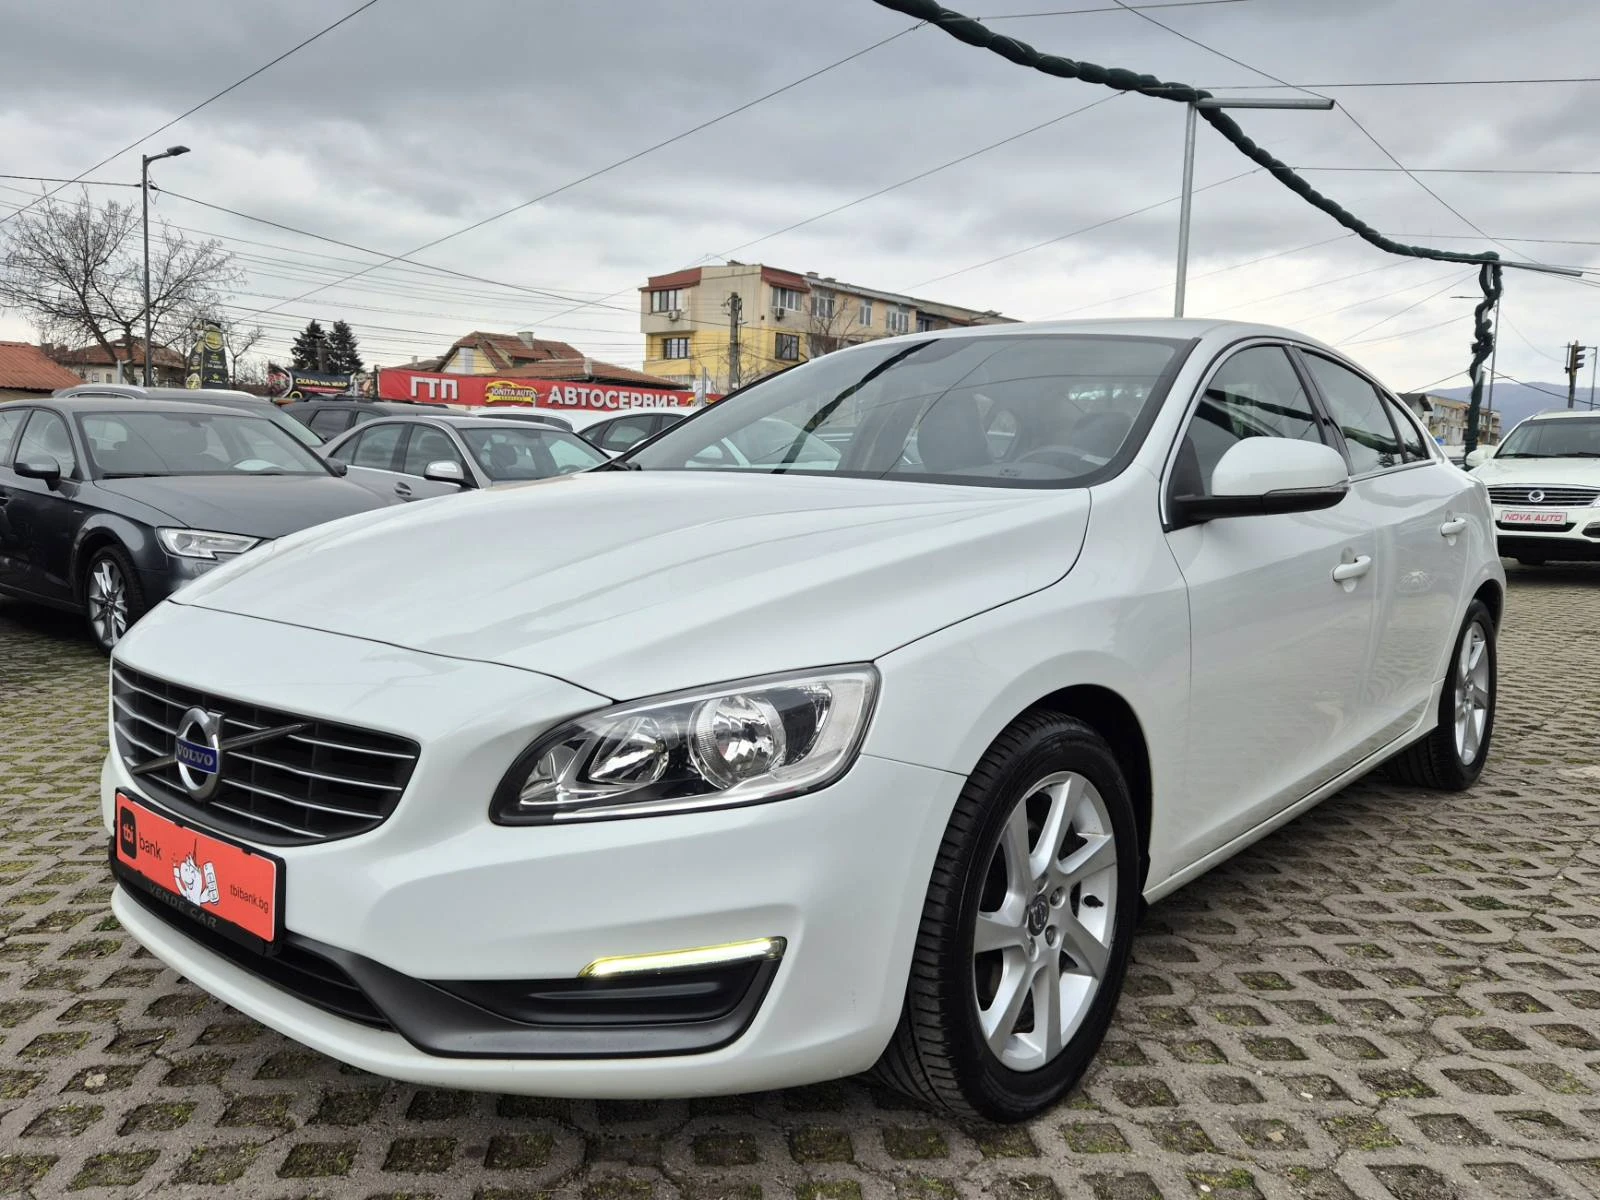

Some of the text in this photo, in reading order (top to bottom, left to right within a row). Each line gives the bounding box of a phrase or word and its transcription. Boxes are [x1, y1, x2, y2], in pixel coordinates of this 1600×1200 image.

[295, 377, 320, 386] СКАРА
[411, 376, 458, 400] ГТП
[516, 389, 535, 398] AUTO
[547, 385, 679, 409] АВТОСЕРВИЗ
[1504, 512, 1563, 522] NOVA AUTO
[177, 743, 214, 767] VOLVO
[122, 823, 134, 845] tbi
[138, 832, 162, 860] bank
[149, 884, 218, 929] VENDE CAR
[229, 884, 269, 914] tbibank.bg
